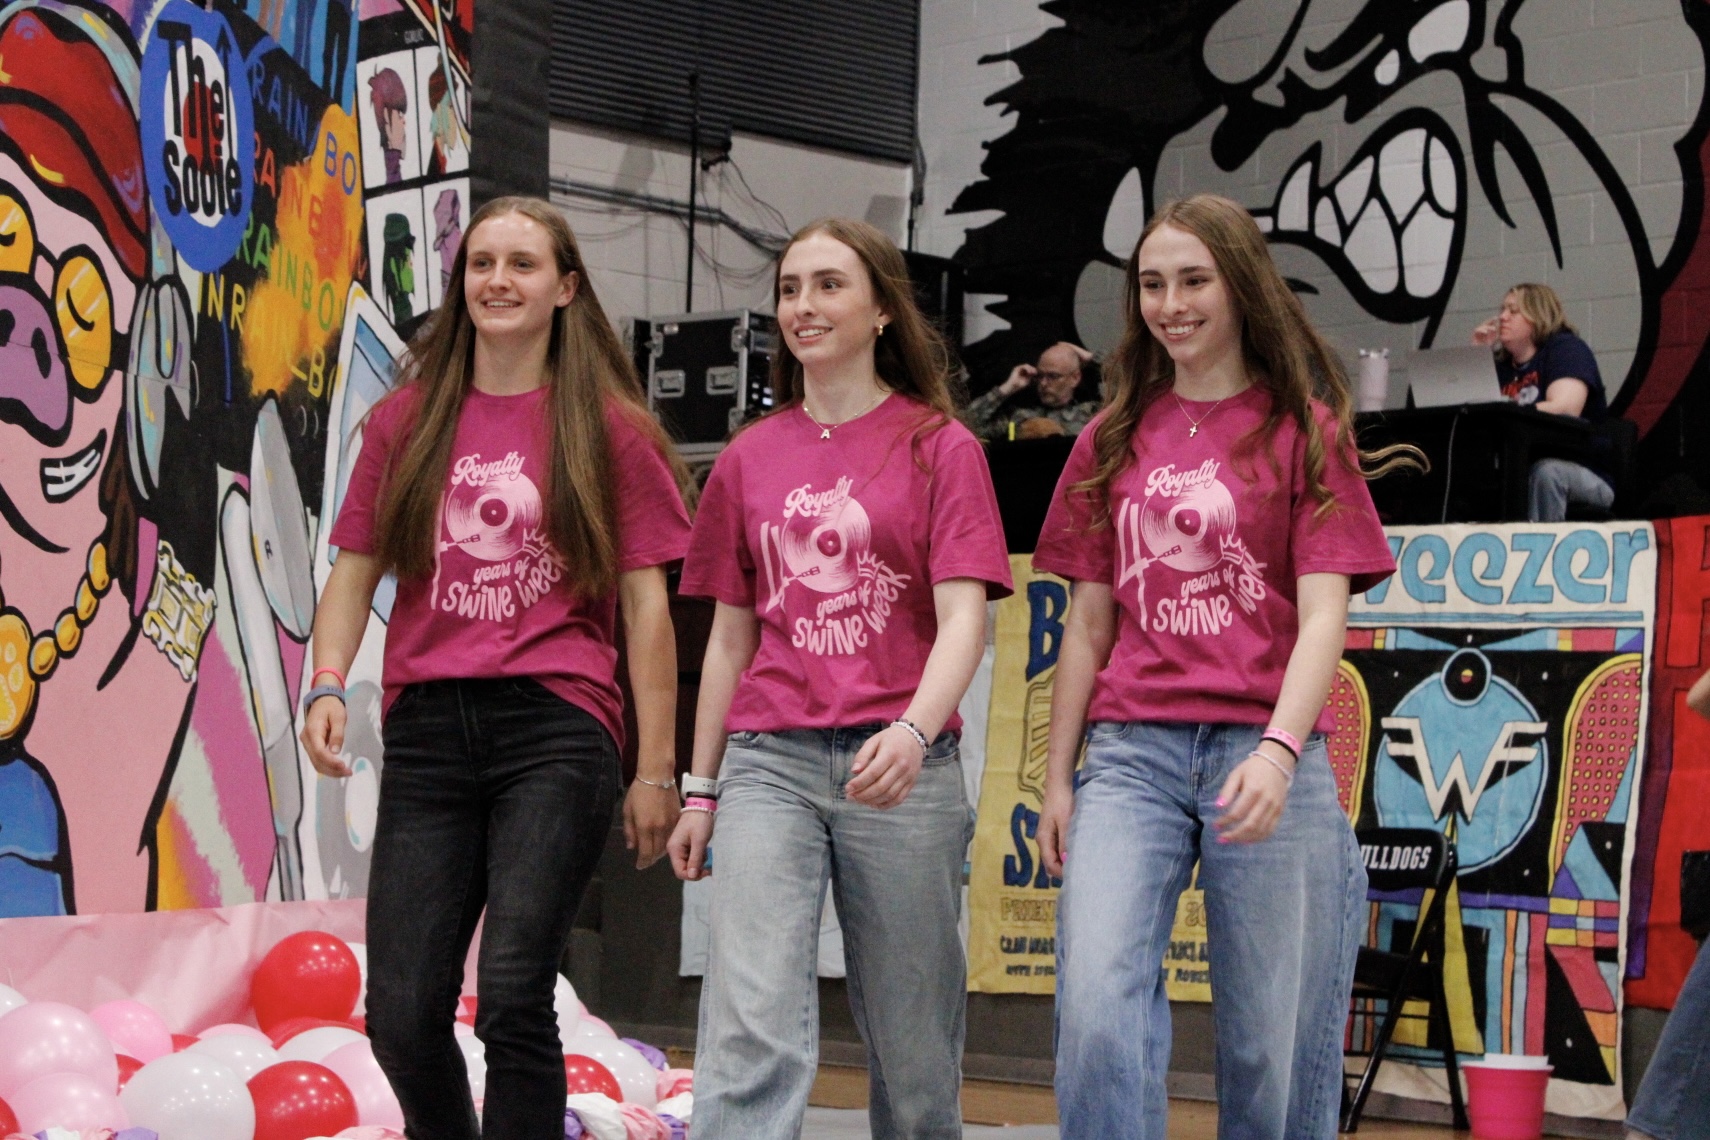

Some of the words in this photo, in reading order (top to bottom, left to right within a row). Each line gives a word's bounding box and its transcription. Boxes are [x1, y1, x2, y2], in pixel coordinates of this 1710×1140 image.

[157, 20, 225, 142] The
[451, 451, 525, 487] Royalty
[1144, 457, 1221, 498] Royalty
[783, 475, 853, 519] Royalty
[473, 561, 511, 589] years
[514, 556, 530, 575] of
[1181, 570, 1221, 606] years
[1222, 564, 1235, 588] of
[816, 590, 857, 626] years
[858, 580, 872, 607] of
[1360, 844, 1433, 870] ULLDOGS
